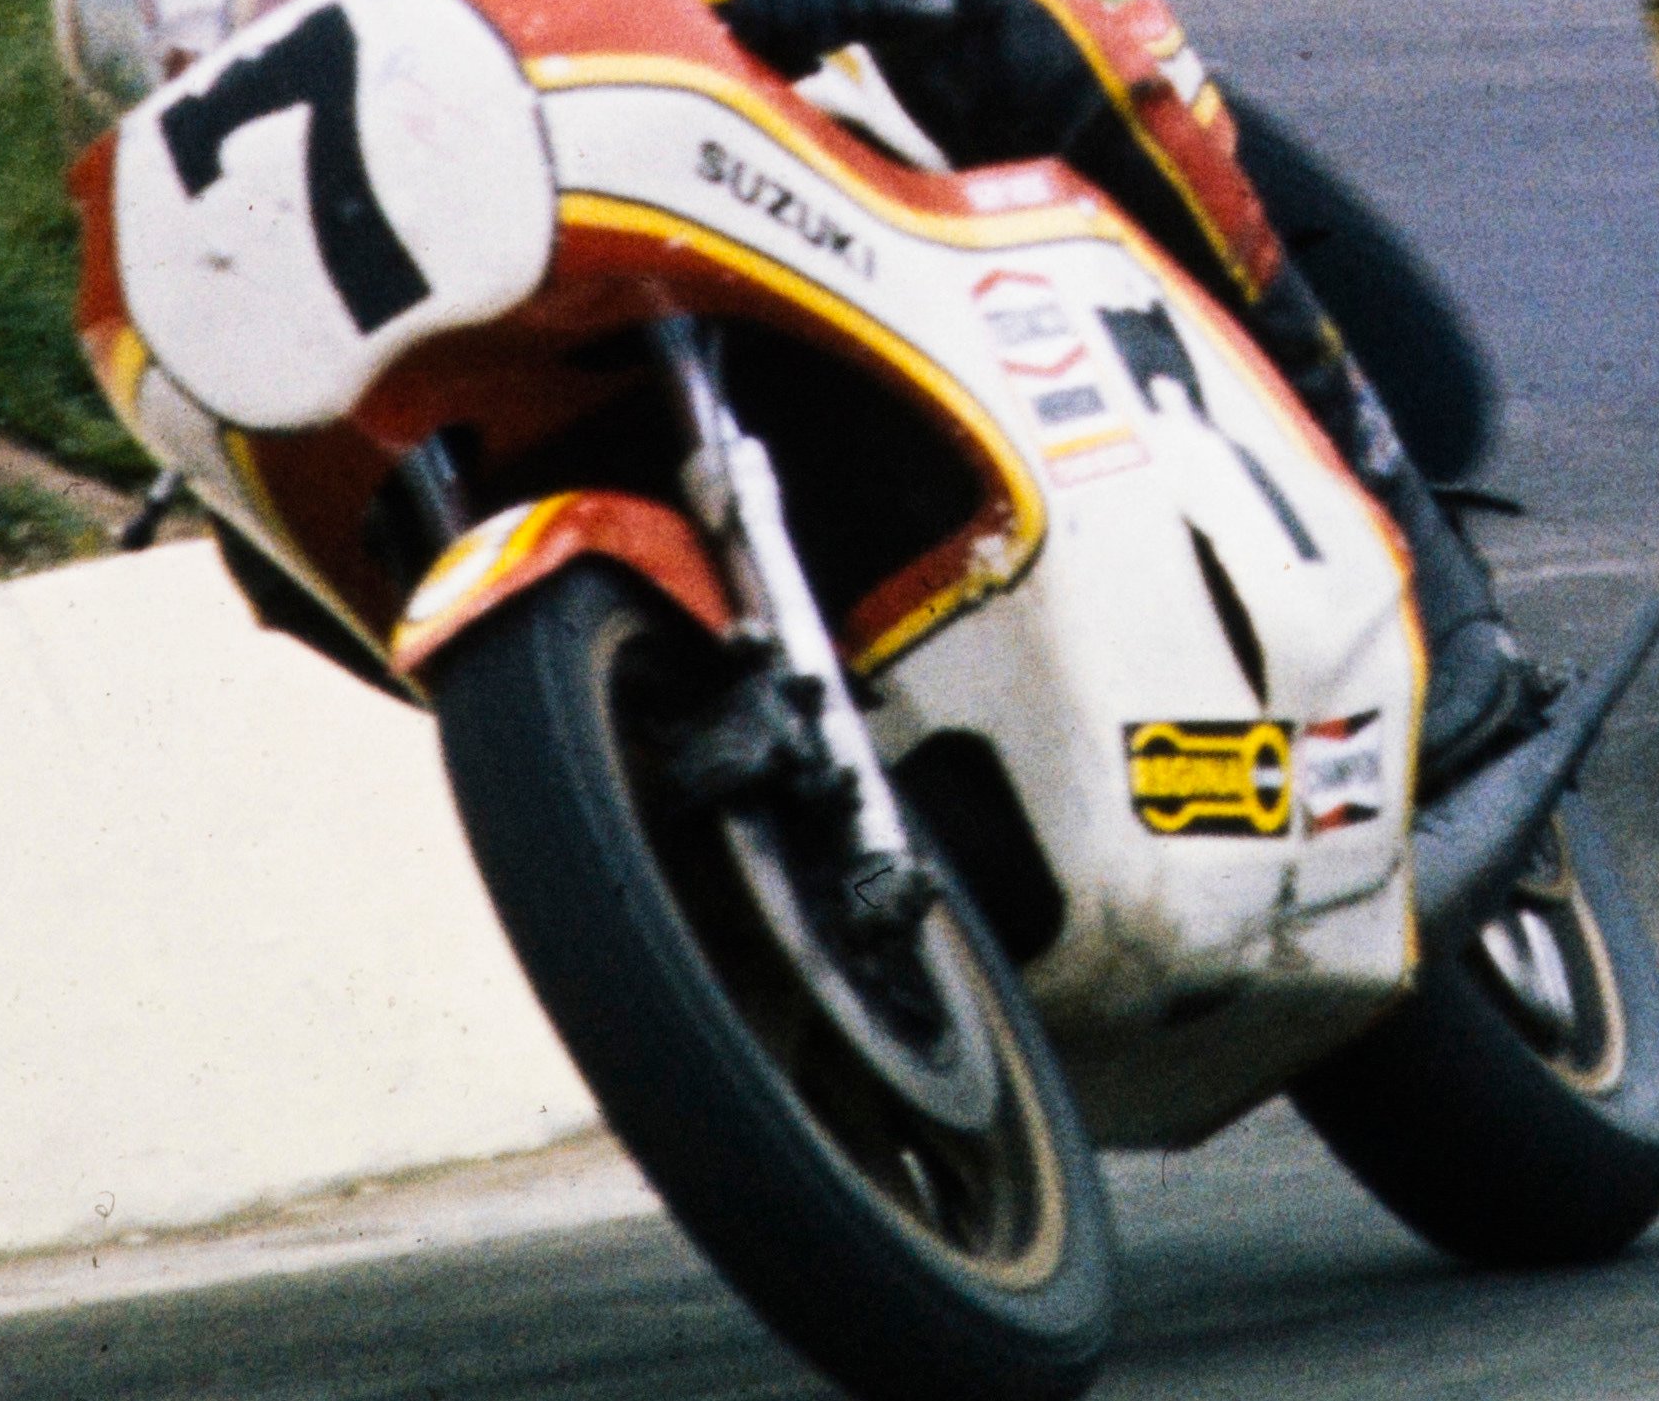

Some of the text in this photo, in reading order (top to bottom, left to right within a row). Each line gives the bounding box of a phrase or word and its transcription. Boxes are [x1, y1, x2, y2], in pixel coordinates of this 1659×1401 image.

[160, 2, 430, 335] 7
[696, 140, 877, 282] SUZUKI
[1095, 297, 1325, 565] 7
